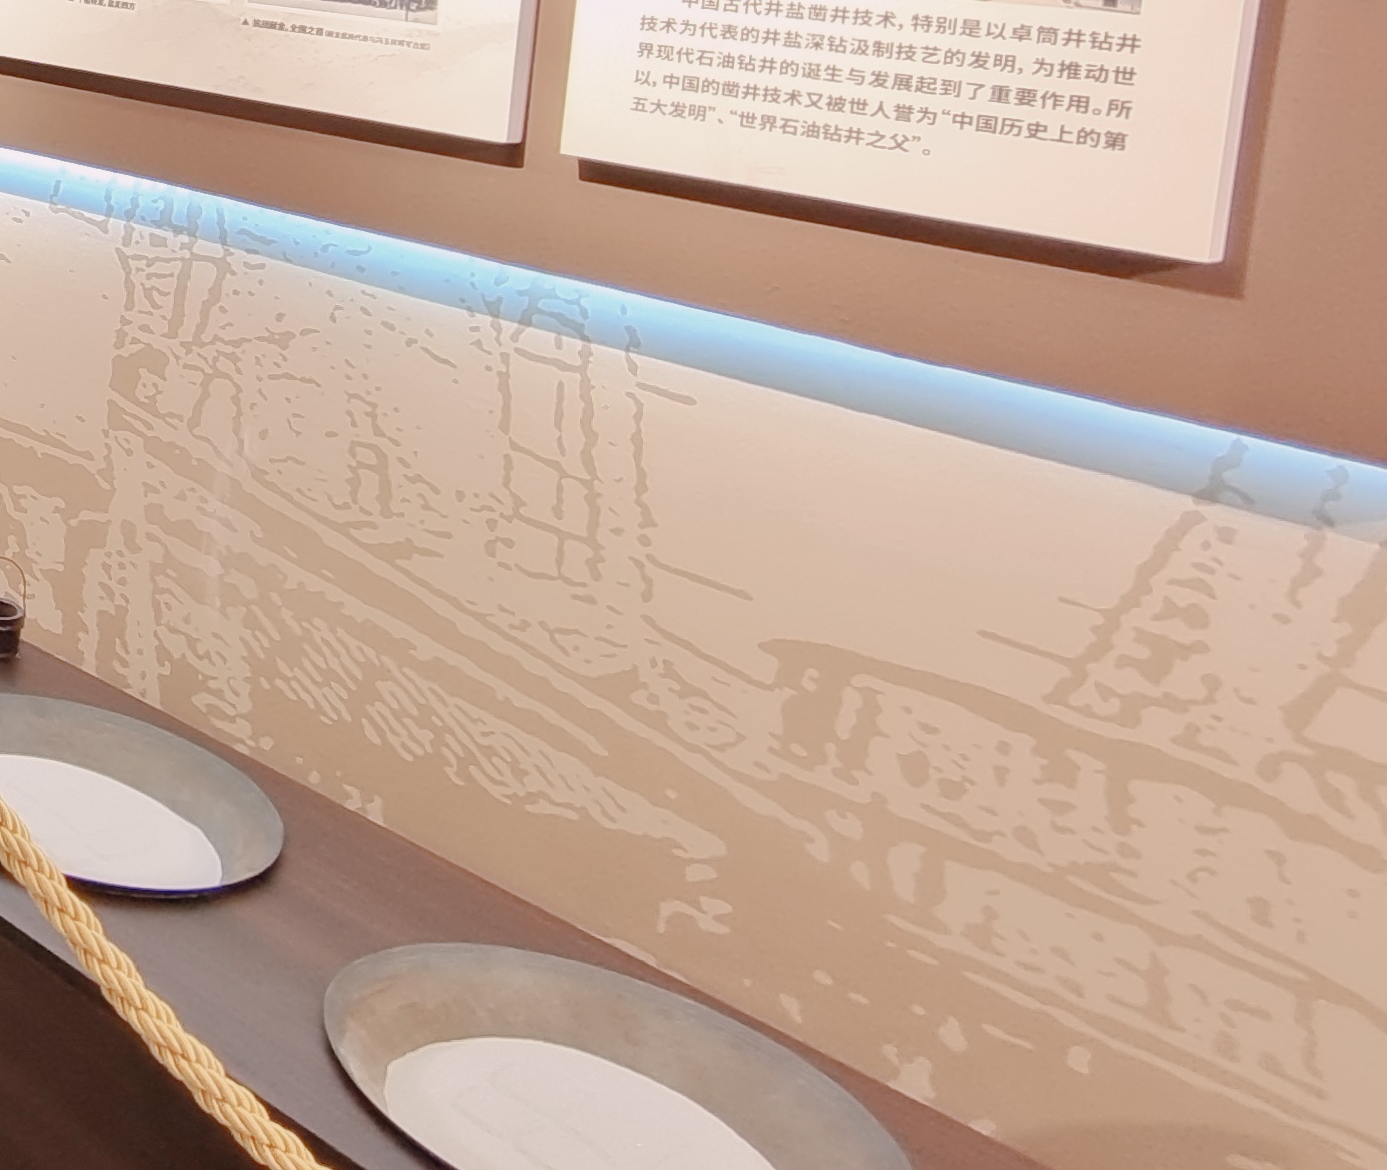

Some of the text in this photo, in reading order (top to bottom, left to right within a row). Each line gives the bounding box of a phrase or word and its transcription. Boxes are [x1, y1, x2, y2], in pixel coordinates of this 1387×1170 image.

[635, 41, 1134, 121] 界现代石油钻井的诞生与发展起到了重要作用。所
[638, 14, 1138, 88] 技术为代表的井盐深钻汲制技艺的发明，为推动世
